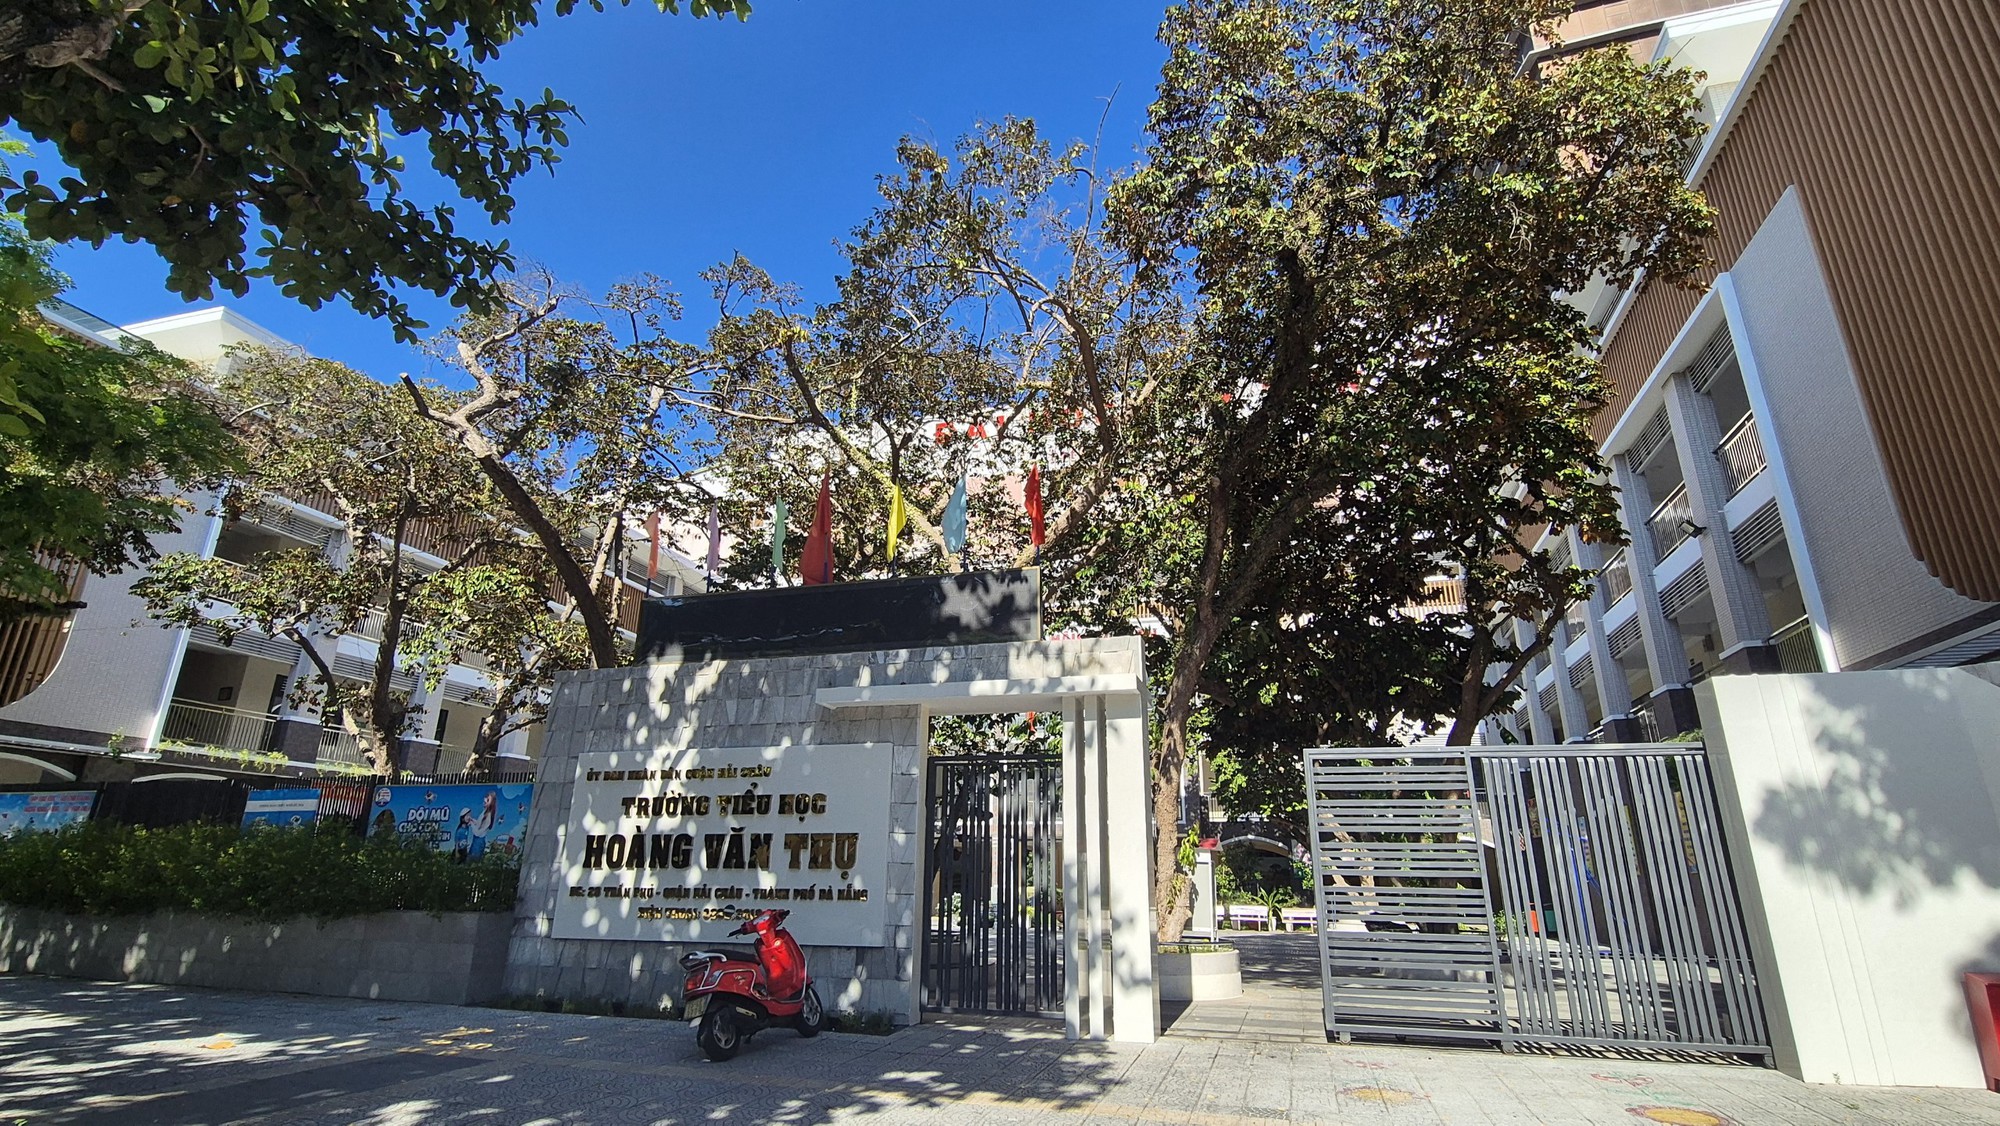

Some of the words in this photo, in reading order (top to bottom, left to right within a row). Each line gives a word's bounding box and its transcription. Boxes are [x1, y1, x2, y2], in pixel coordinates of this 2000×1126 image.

[407, 806, 428, 823] ĐỘI
[429, 805, 450, 821] MŨ
[622, 790, 711, 817] TRƯỜNG
[717, 782, 773, 815] TIỂU
[778, 793, 828, 823] HỌC
[582, 826, 694, 870] HOÀNG
[704, 826, 774, 870] VĂN
[784, 832, 860, 880] THỤ
